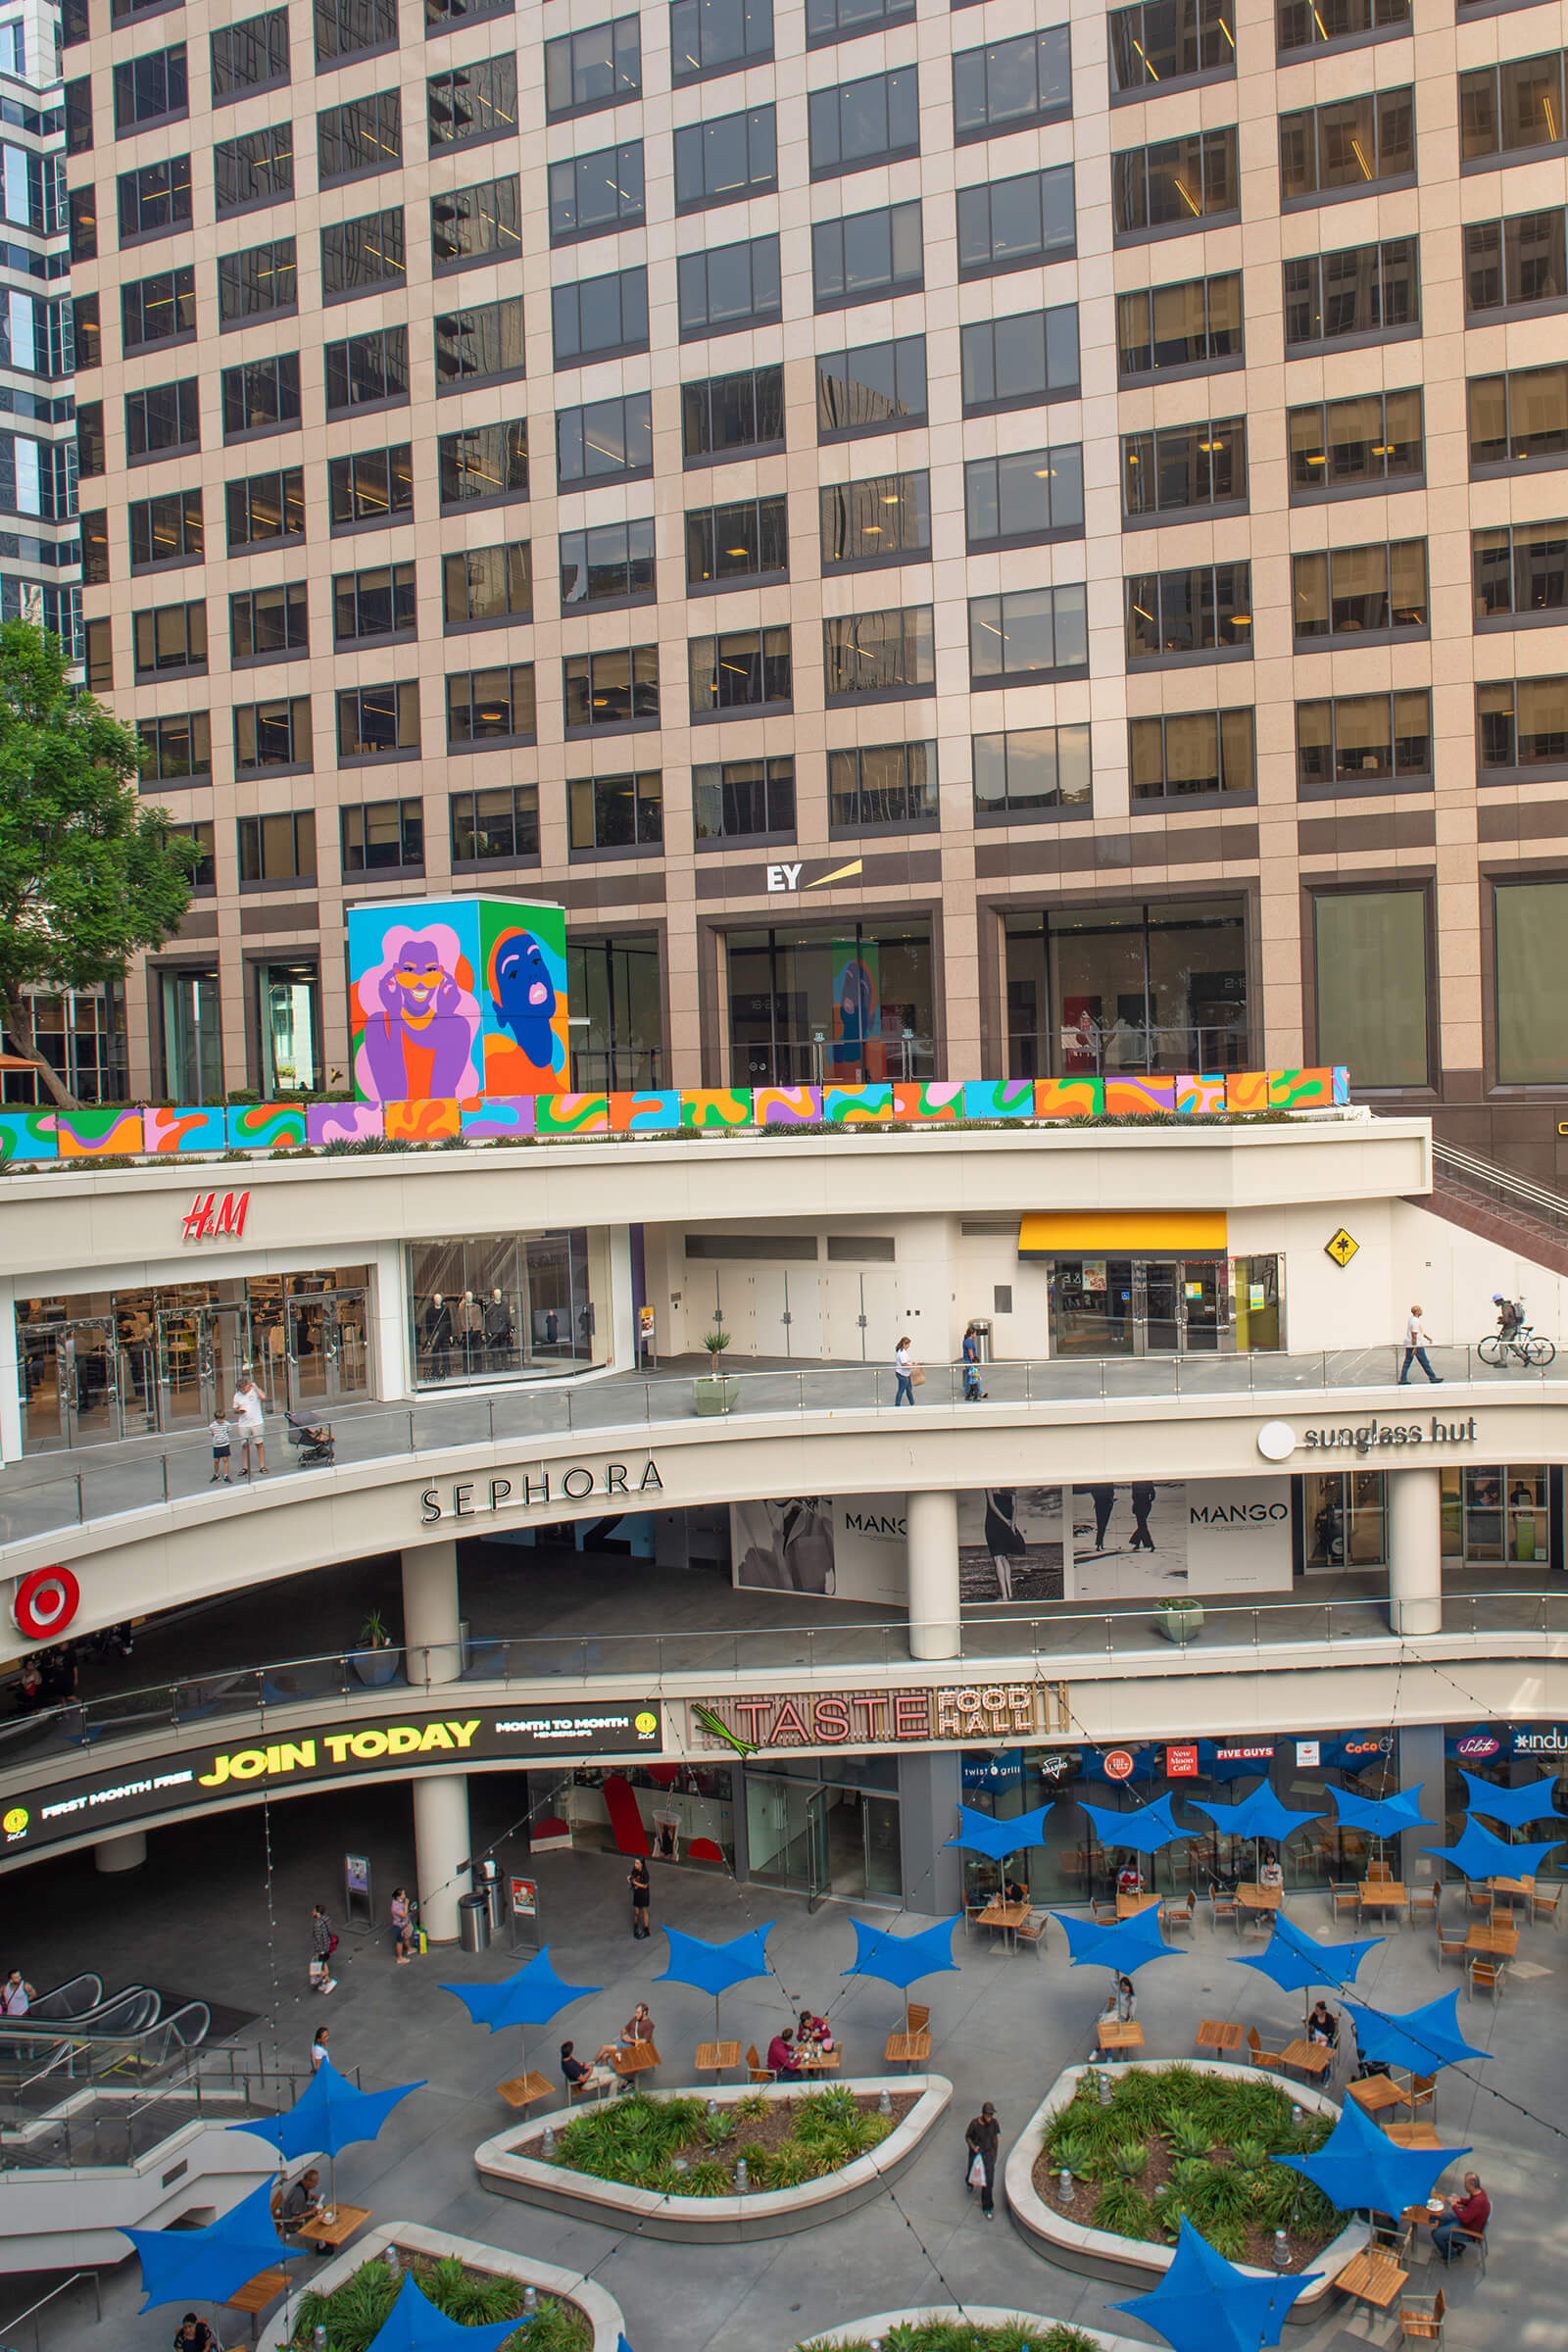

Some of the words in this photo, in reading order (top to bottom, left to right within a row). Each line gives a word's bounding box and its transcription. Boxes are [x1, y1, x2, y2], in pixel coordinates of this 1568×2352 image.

[767, 863, 803, 891] EY
[180, 1191, 251, 1240] H&M
[1304, 1418, 1423, 1454] sunglass
[1431, 1416, 1478, 1444] hut
[421, 1459, 665, 1524] SEPHORA
[1190, 1503, 1288, 1524] MANGO
[937, 1688, 1032, 1713] FOOD
[495, 1720, 551, 1733] MONTH
[552, 1719, 573, 1731] TO
[574, 1717, 630, 1729] MONTH
[735, 1694, 930, 1745] TASTE
[938, 1710, 1033, 1736] HALL
[533, 1729, 594, 1740] MEMBERSHIPS
[198, 1740, 317, 1787] JOIN
[323, 1719, 482, 1764] TODAY
[1169, 1756, 1195, 1765] Moon
[1217, 1749, 1241, 1759] FIVE
[1243, 1747, 1272, 1757] GUYS
[964, 1767, 988, 1777] twist
[1000, 1766, 1020, 1777] grill
[41, 1796, 89, 1820] FIRST
[88, 1779, 153, 1806] MONTH
[153, 1769, 193, 1790] FREE
